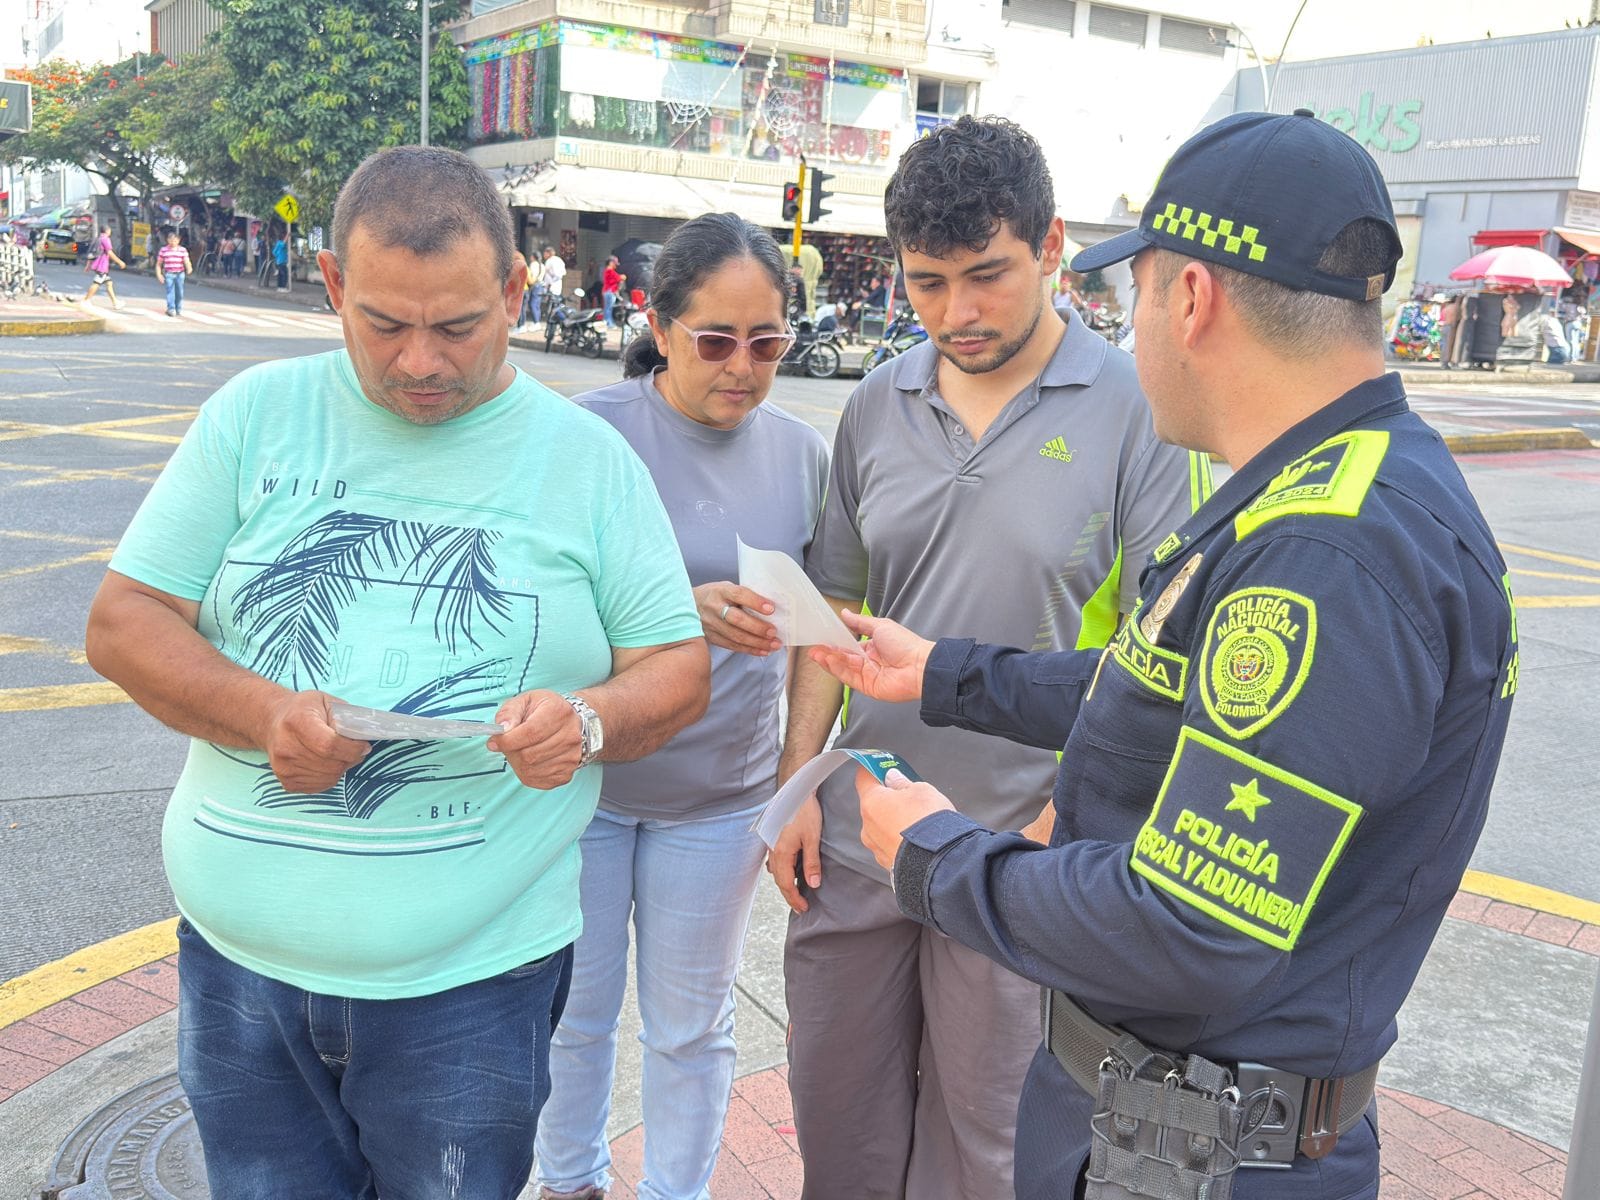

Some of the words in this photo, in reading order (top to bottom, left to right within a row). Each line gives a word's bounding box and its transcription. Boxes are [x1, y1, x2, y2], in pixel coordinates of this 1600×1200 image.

[704, 47, 742, 61] NAVIDA
[1039, 448, 1072, 463] adidas
[262, 477, 347, 499] WILD
[500, 577, 531, 589] AND
[1228, 597, 1290, 618] POLICÍA
[1217, 612, 1300, 641] NACIONAL
[1215, 701, 1268, 718] COLOMBIA
[1174, 808, 1279, 883] POLICÍA
[1183, 850, 1204, 881] Y
[1193, 861, 1302, 933] ADUANERA
[109, 1099, 192, 1200] ARAMANG
